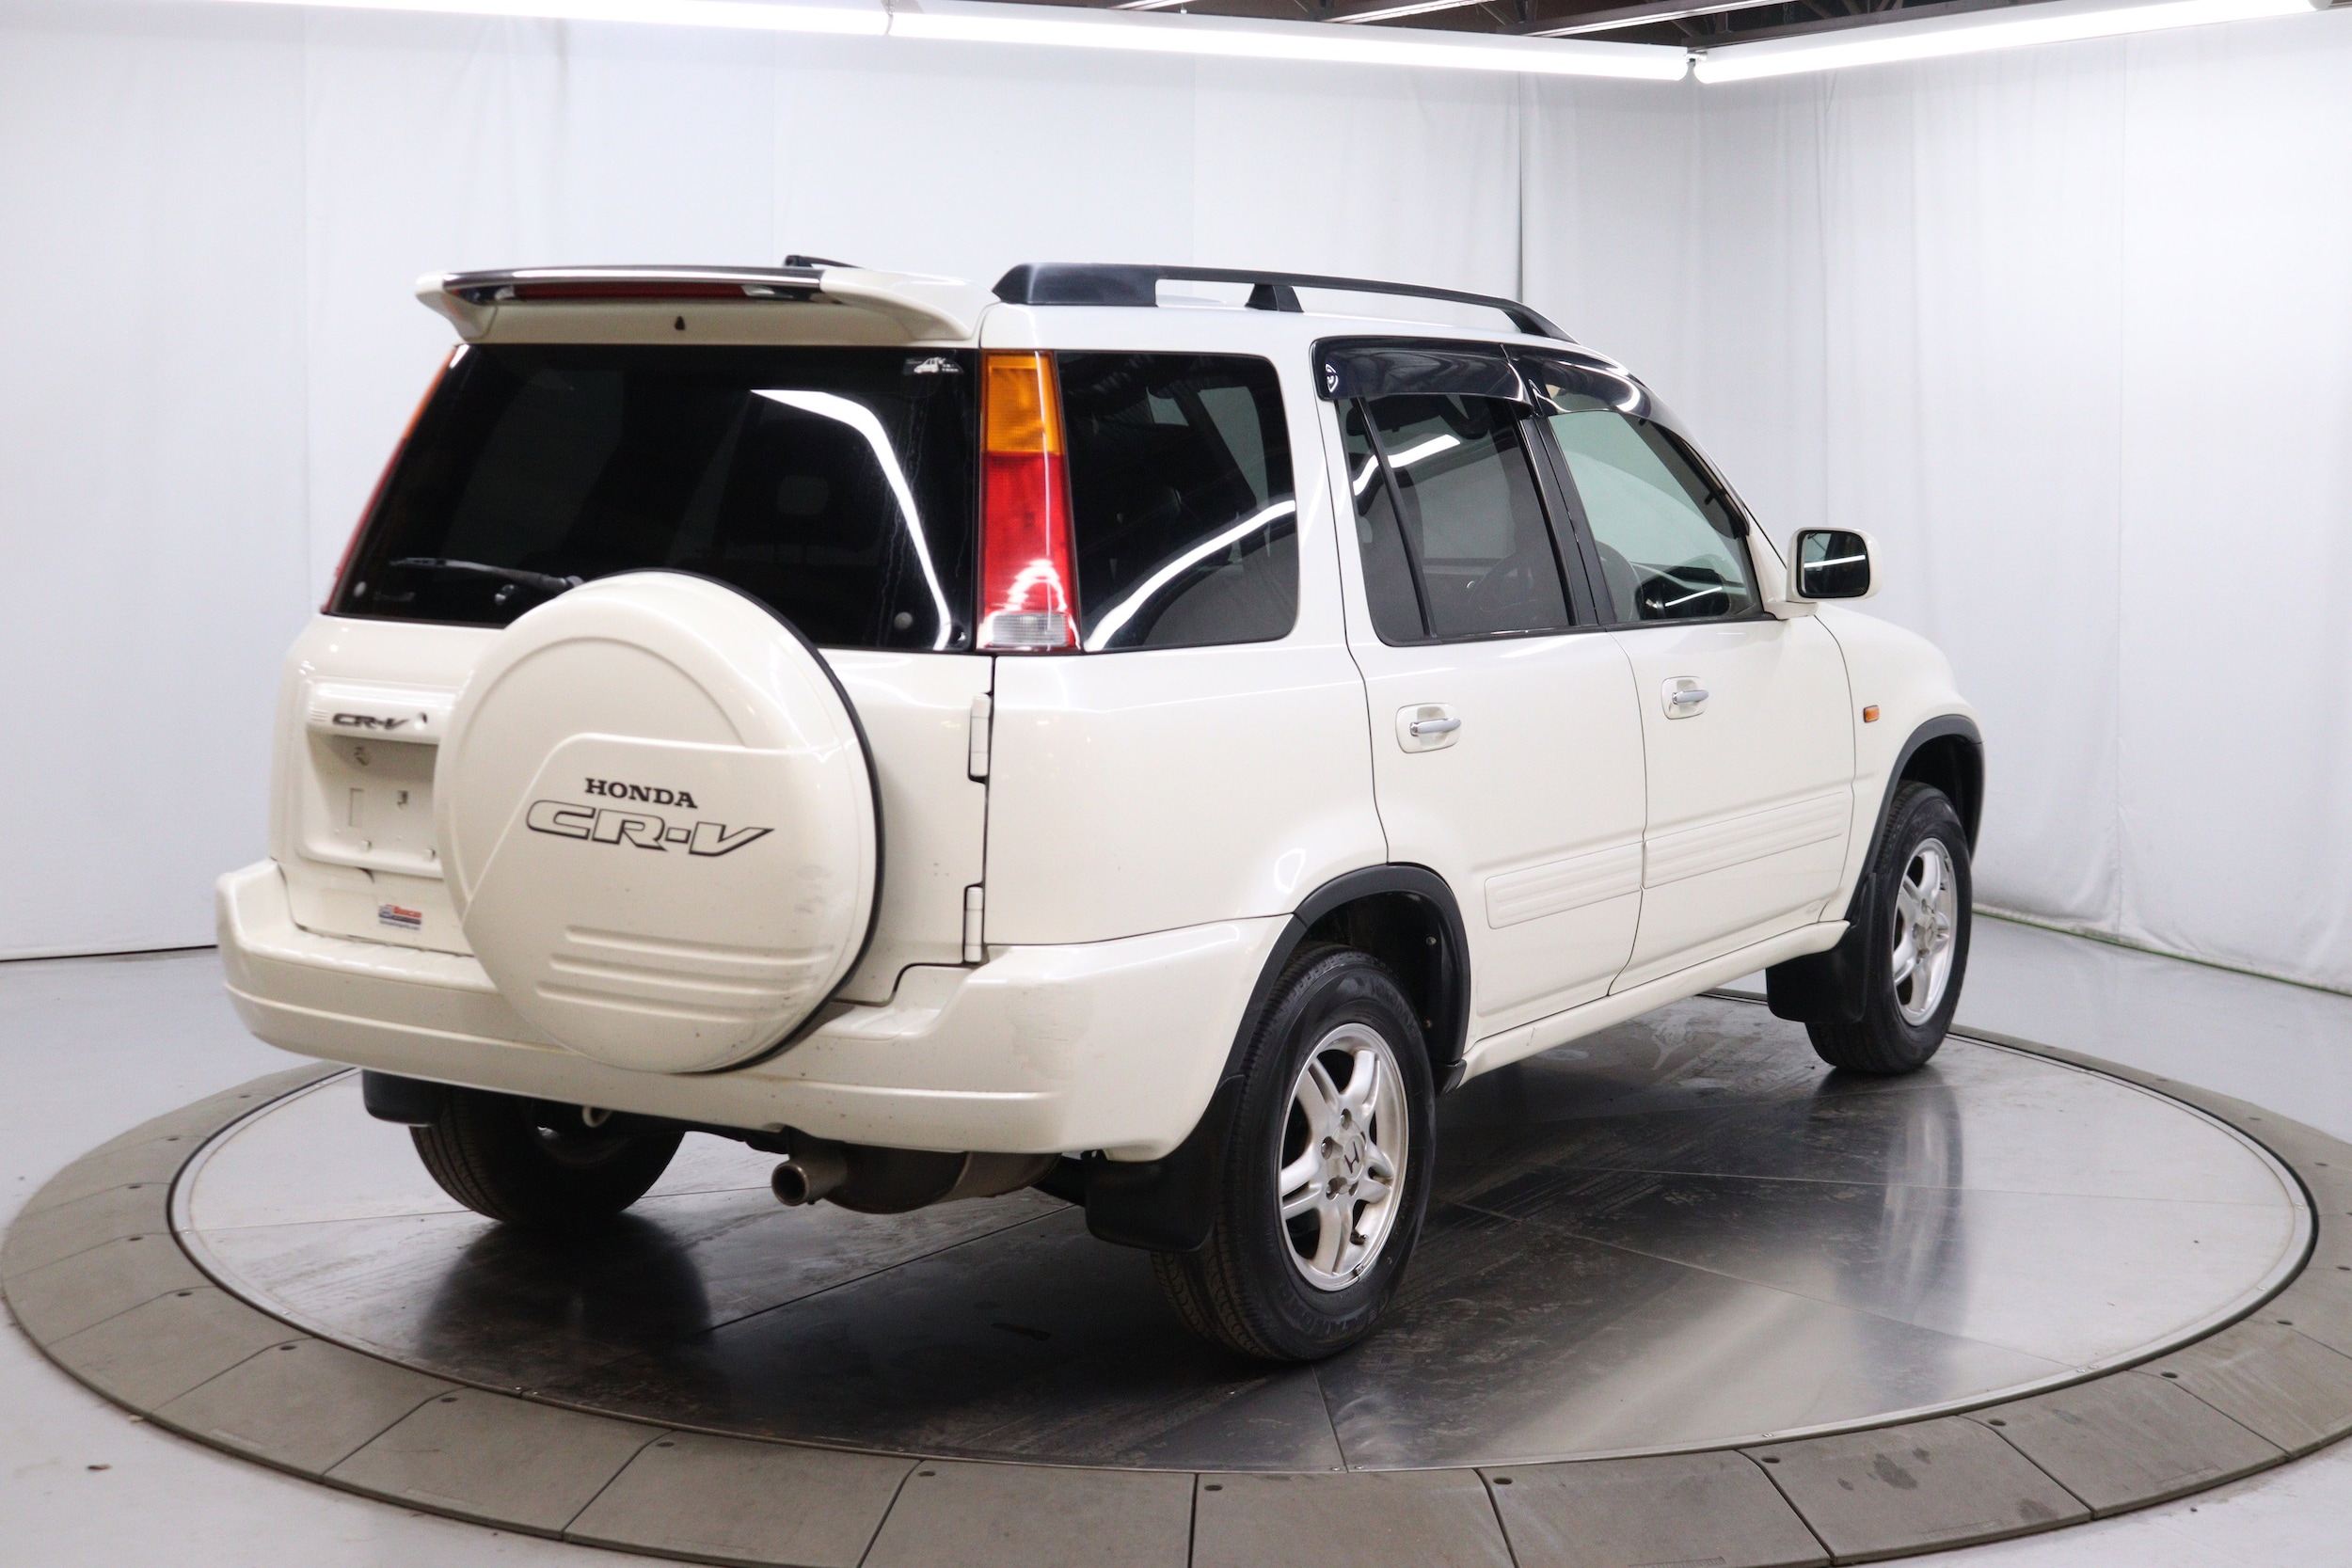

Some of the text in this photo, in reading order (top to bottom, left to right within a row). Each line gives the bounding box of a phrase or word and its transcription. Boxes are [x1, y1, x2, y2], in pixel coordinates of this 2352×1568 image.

[332, 712, 409, 730] CR-V
[584, 777, 698, 809] HONDA
[526, 800, 775, 857] CR-V
